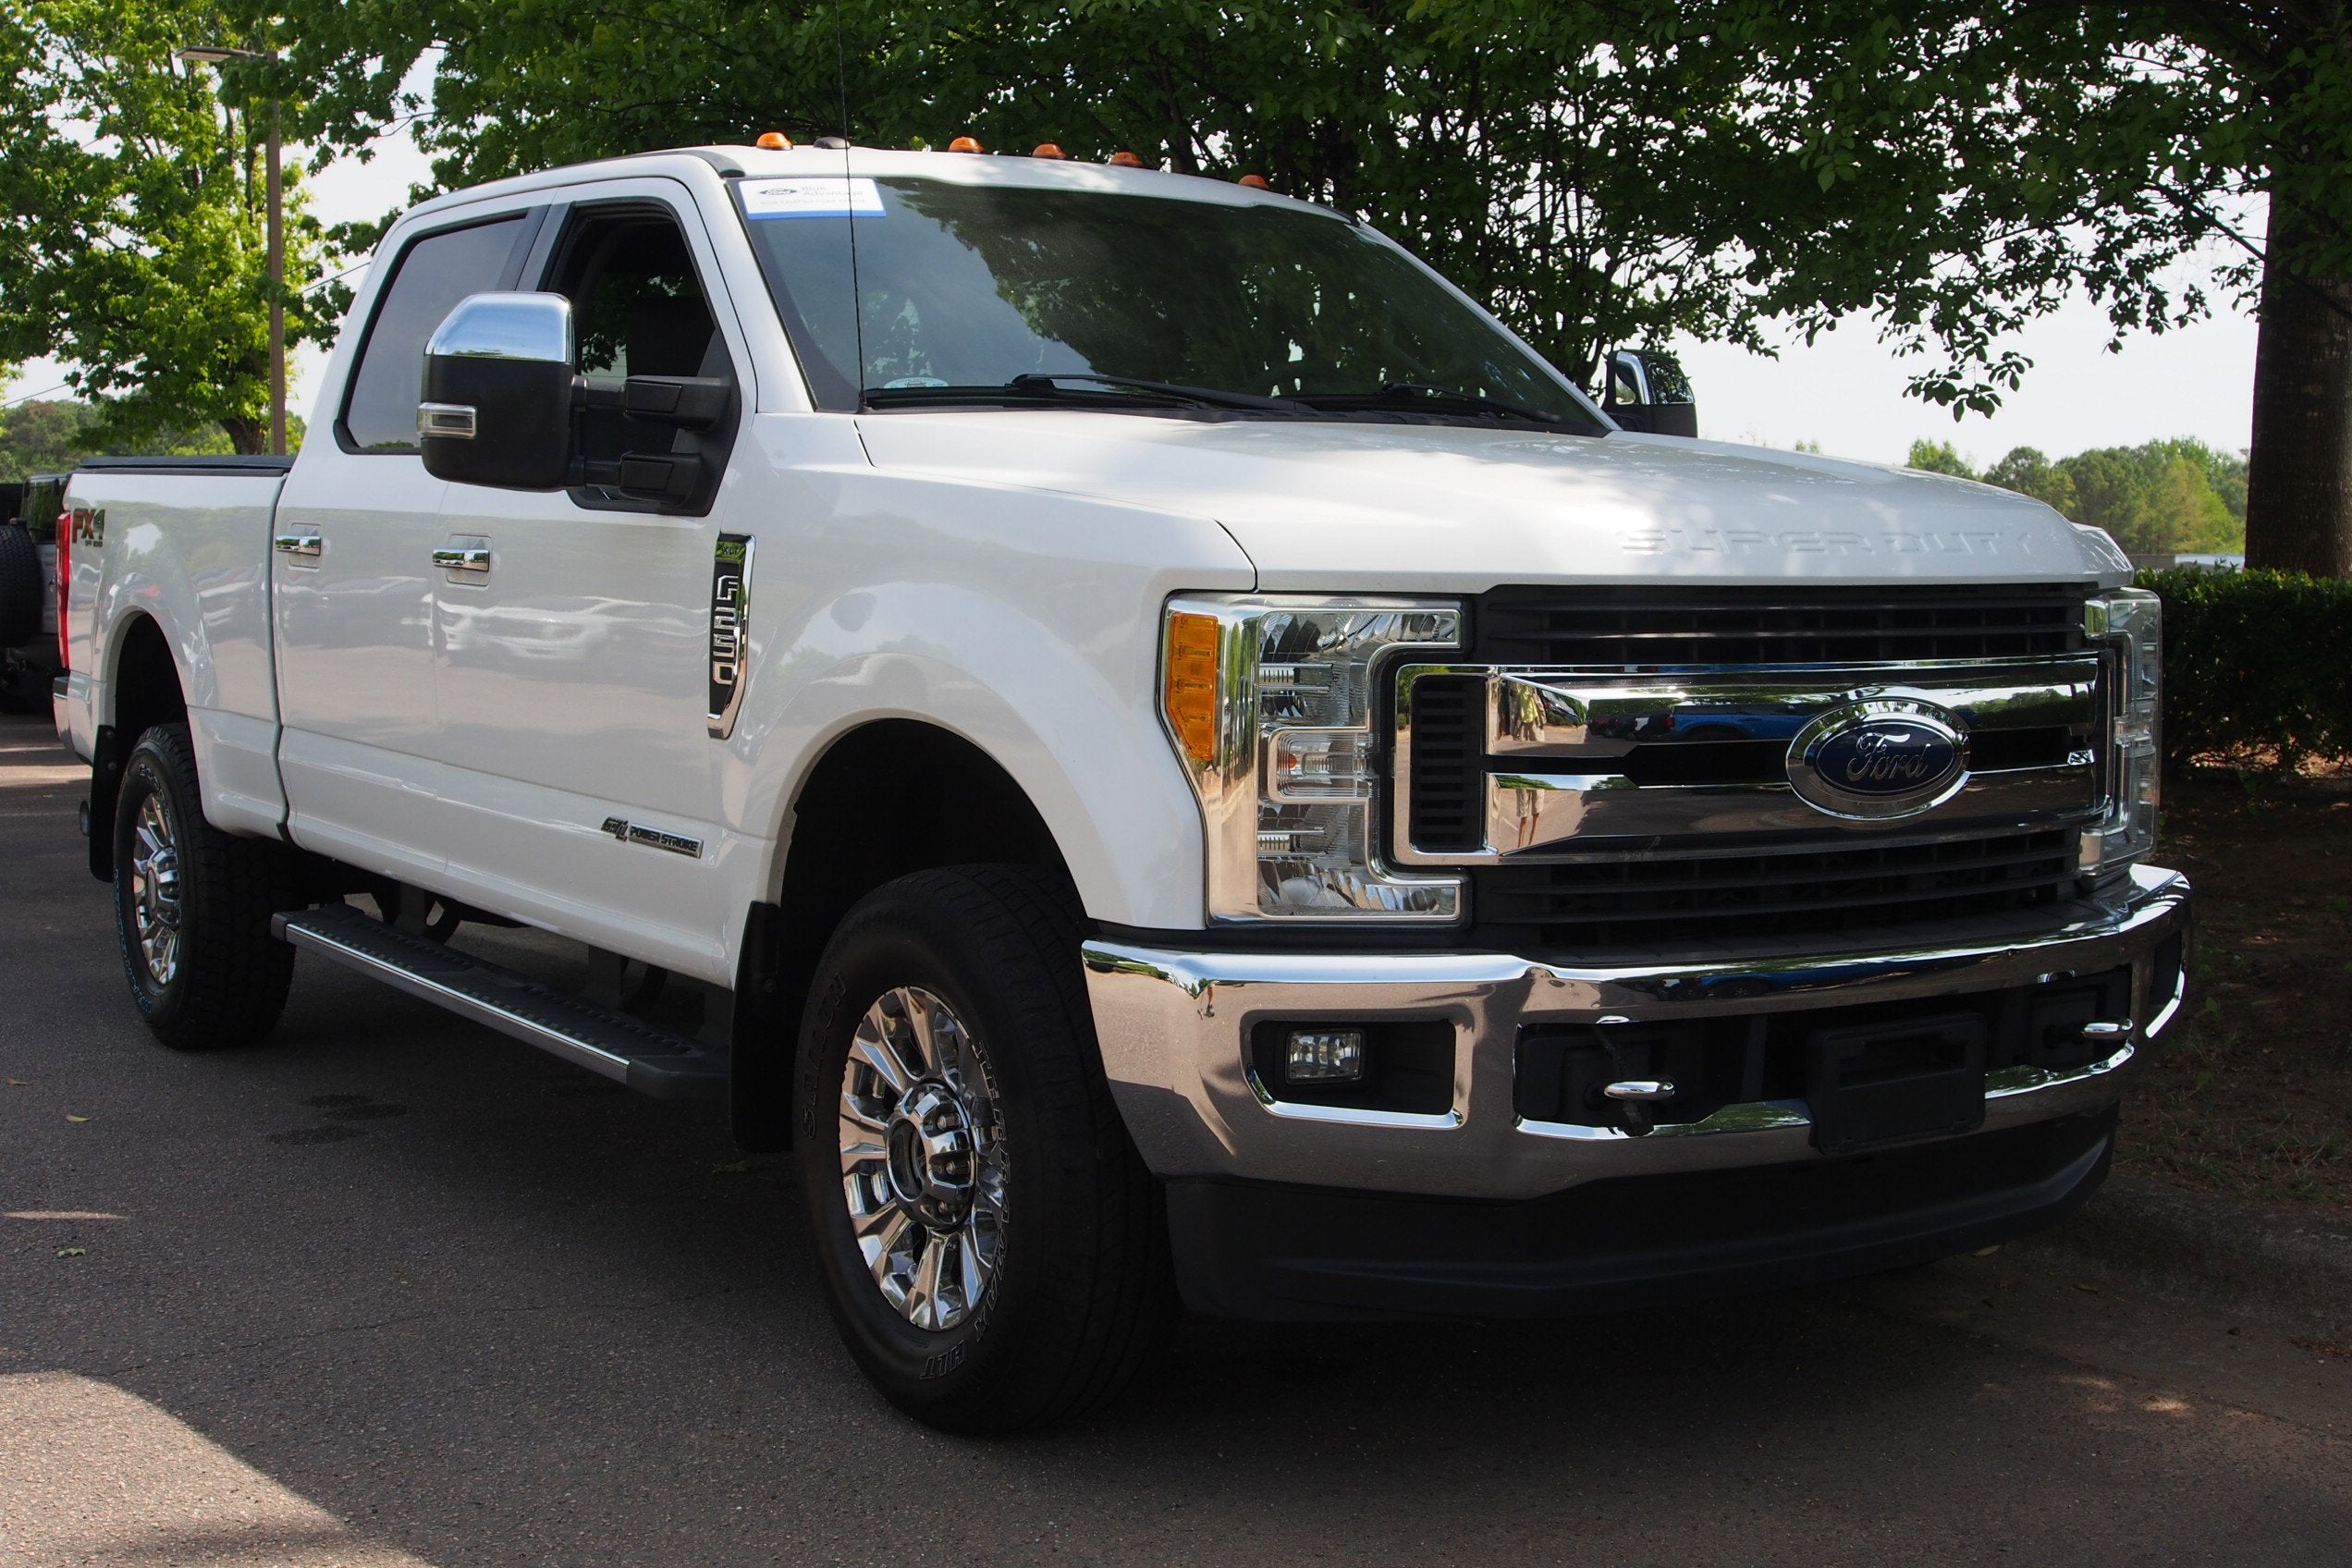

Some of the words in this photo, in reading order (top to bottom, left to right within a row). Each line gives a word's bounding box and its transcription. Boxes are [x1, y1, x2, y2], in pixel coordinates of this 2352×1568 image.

[72, 508, 105, 544] FX4
[1620, 529, 1876, 555] SUPER
[1846, 731, 1931, 782] Ford
[919, 1339, 968, 1380] HLT
